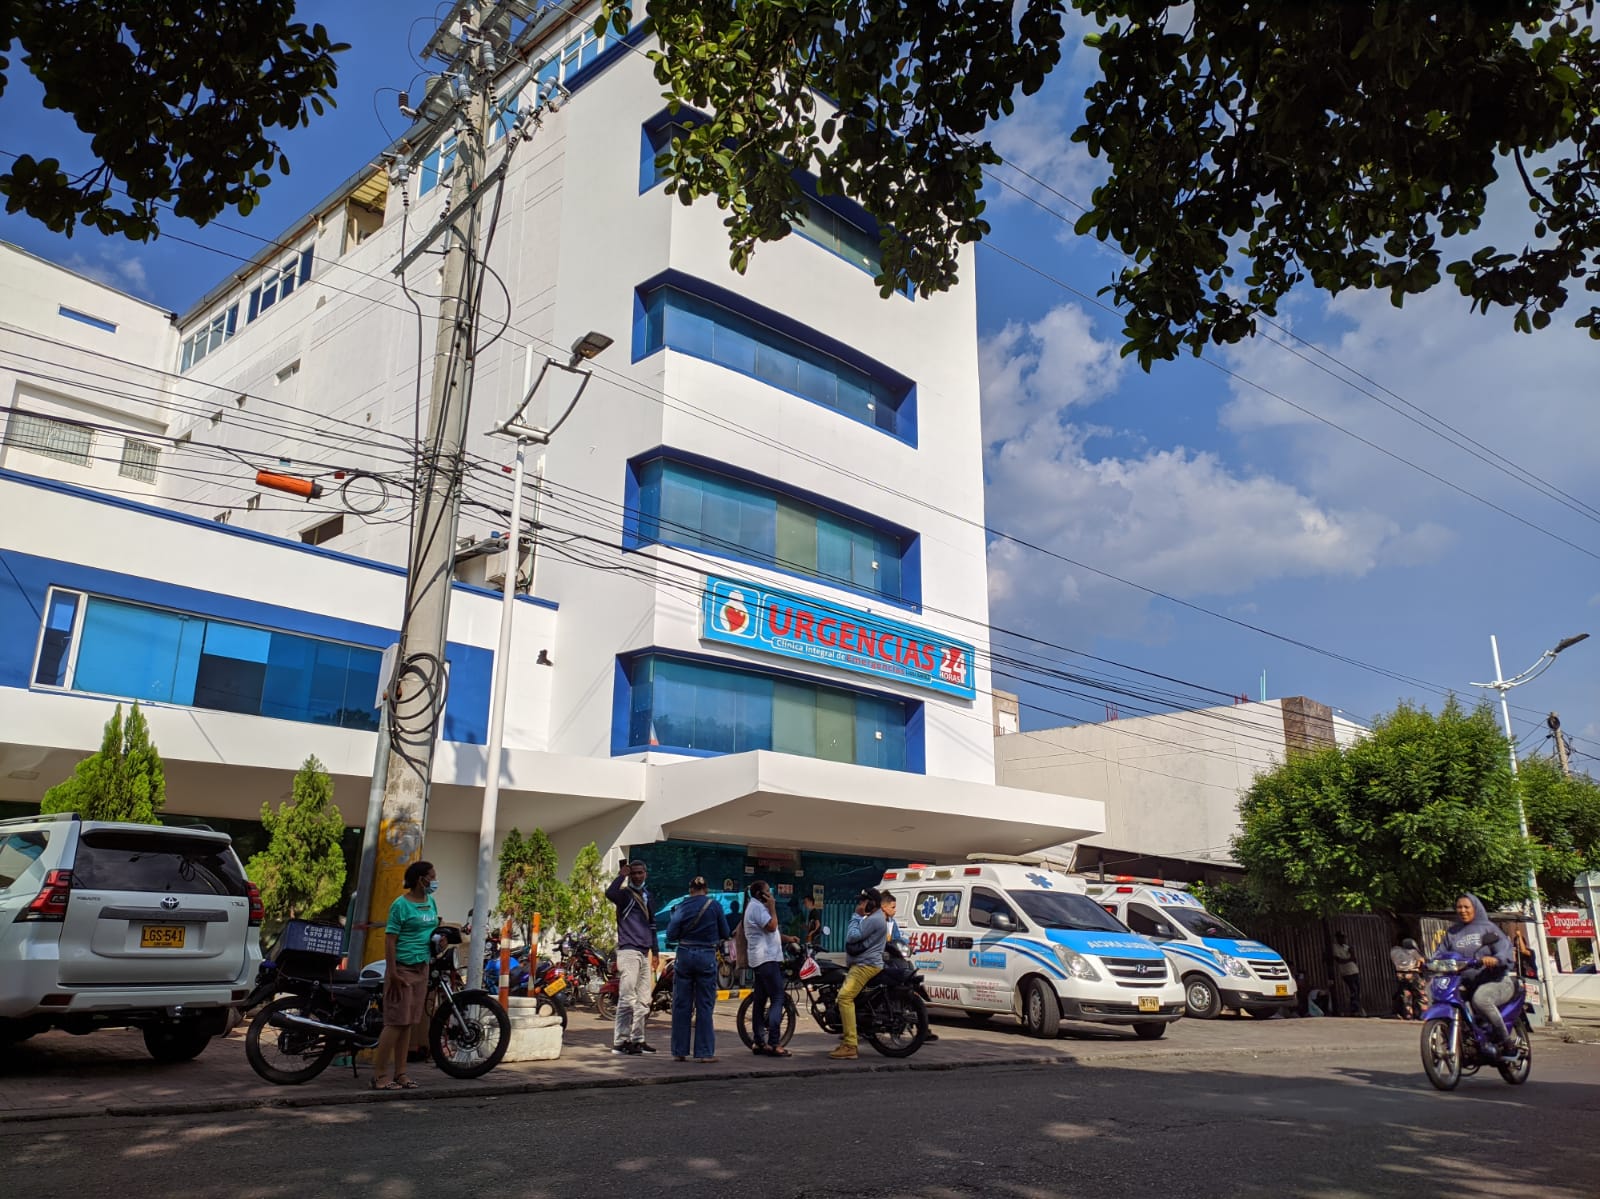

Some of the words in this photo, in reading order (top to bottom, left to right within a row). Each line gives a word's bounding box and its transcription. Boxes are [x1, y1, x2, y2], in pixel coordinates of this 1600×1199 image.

[768, 604, 934, 671] URGENCIAS
[805, 643, 834, 658] Integral
[836, 651, 846, 660] de
[847, 653, 905, 674] Emergencias
[940, 647, 966, 684] 24
[940, 671, 961, 684] HORAS
[908, 932, 944, 953] #901
[927, 986, 960, 1001] LANCIA
